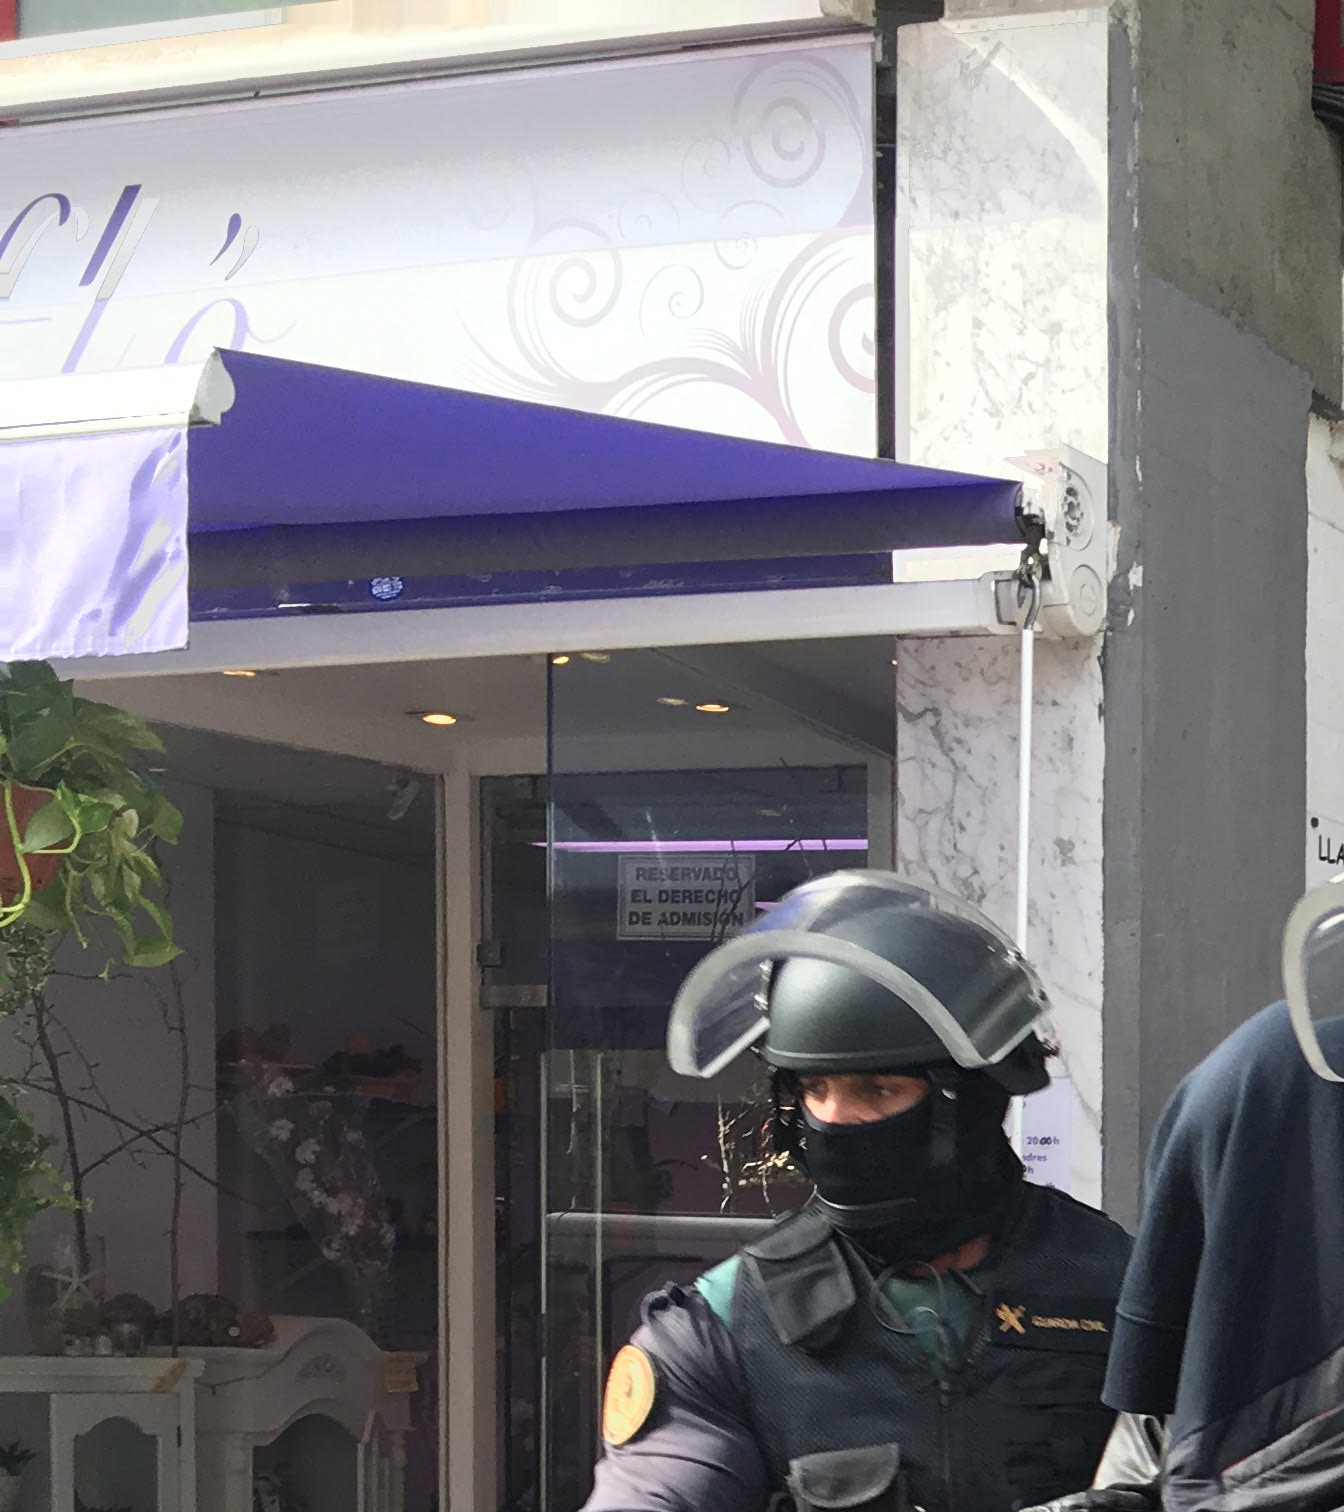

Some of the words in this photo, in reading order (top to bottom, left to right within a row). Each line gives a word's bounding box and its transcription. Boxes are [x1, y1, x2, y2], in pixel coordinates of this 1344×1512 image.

[635, 866, 738, 881] RESERVADO
[631, 889, 652, 903] EL
[658, 888, 740, 903] DERECHO
[628, 911, 652, 926] DE
